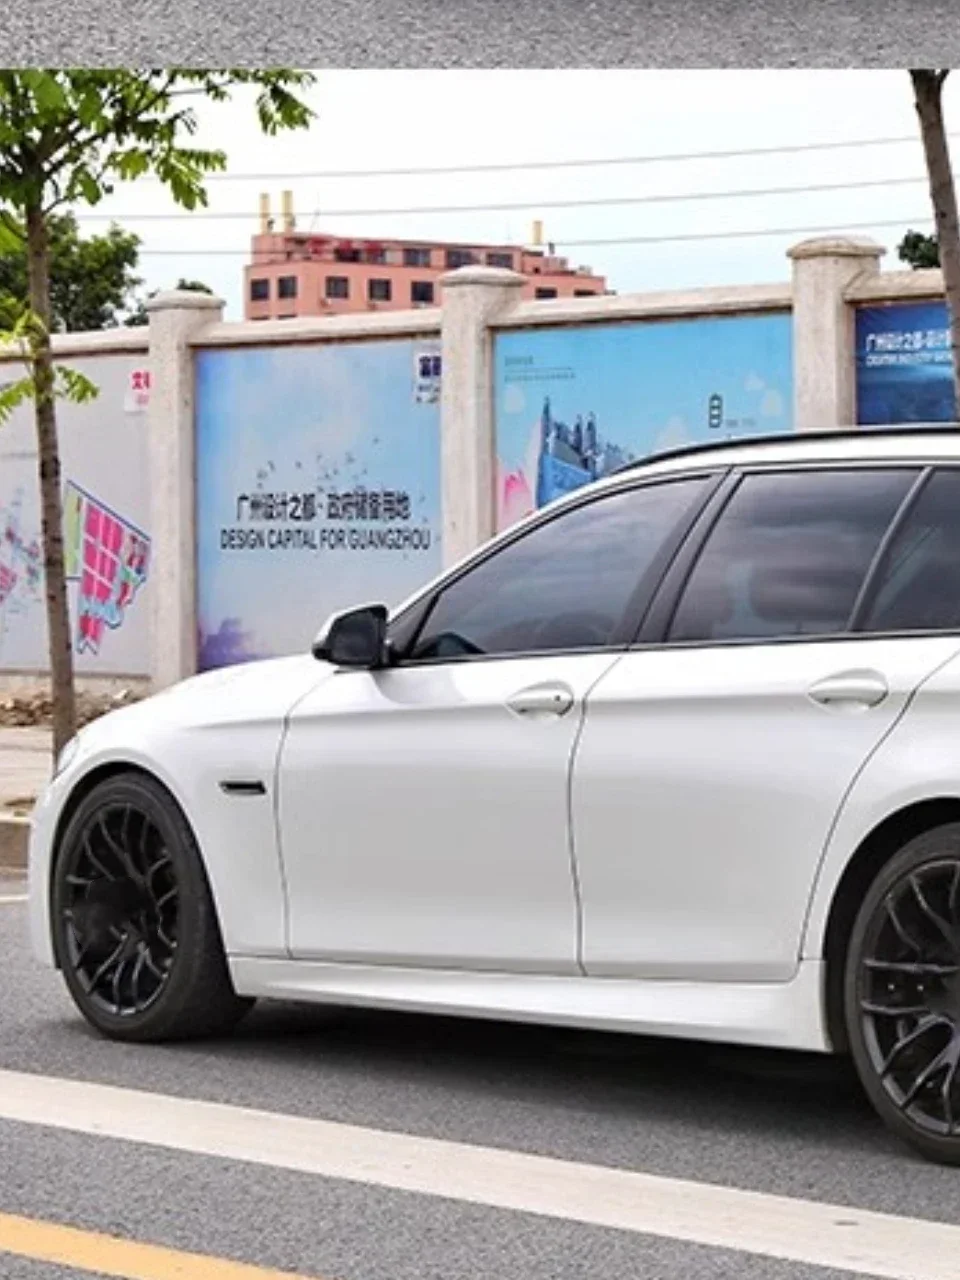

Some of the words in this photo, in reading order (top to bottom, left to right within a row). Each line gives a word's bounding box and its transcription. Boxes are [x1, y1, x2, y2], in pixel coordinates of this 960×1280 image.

[220, 529, 265, 551] DESIGN
[267, 529, 318, 551] CAPITAL
[319, 529, 348, 551] FOR
[349, 528, 432, 551] GUANGZHOU
